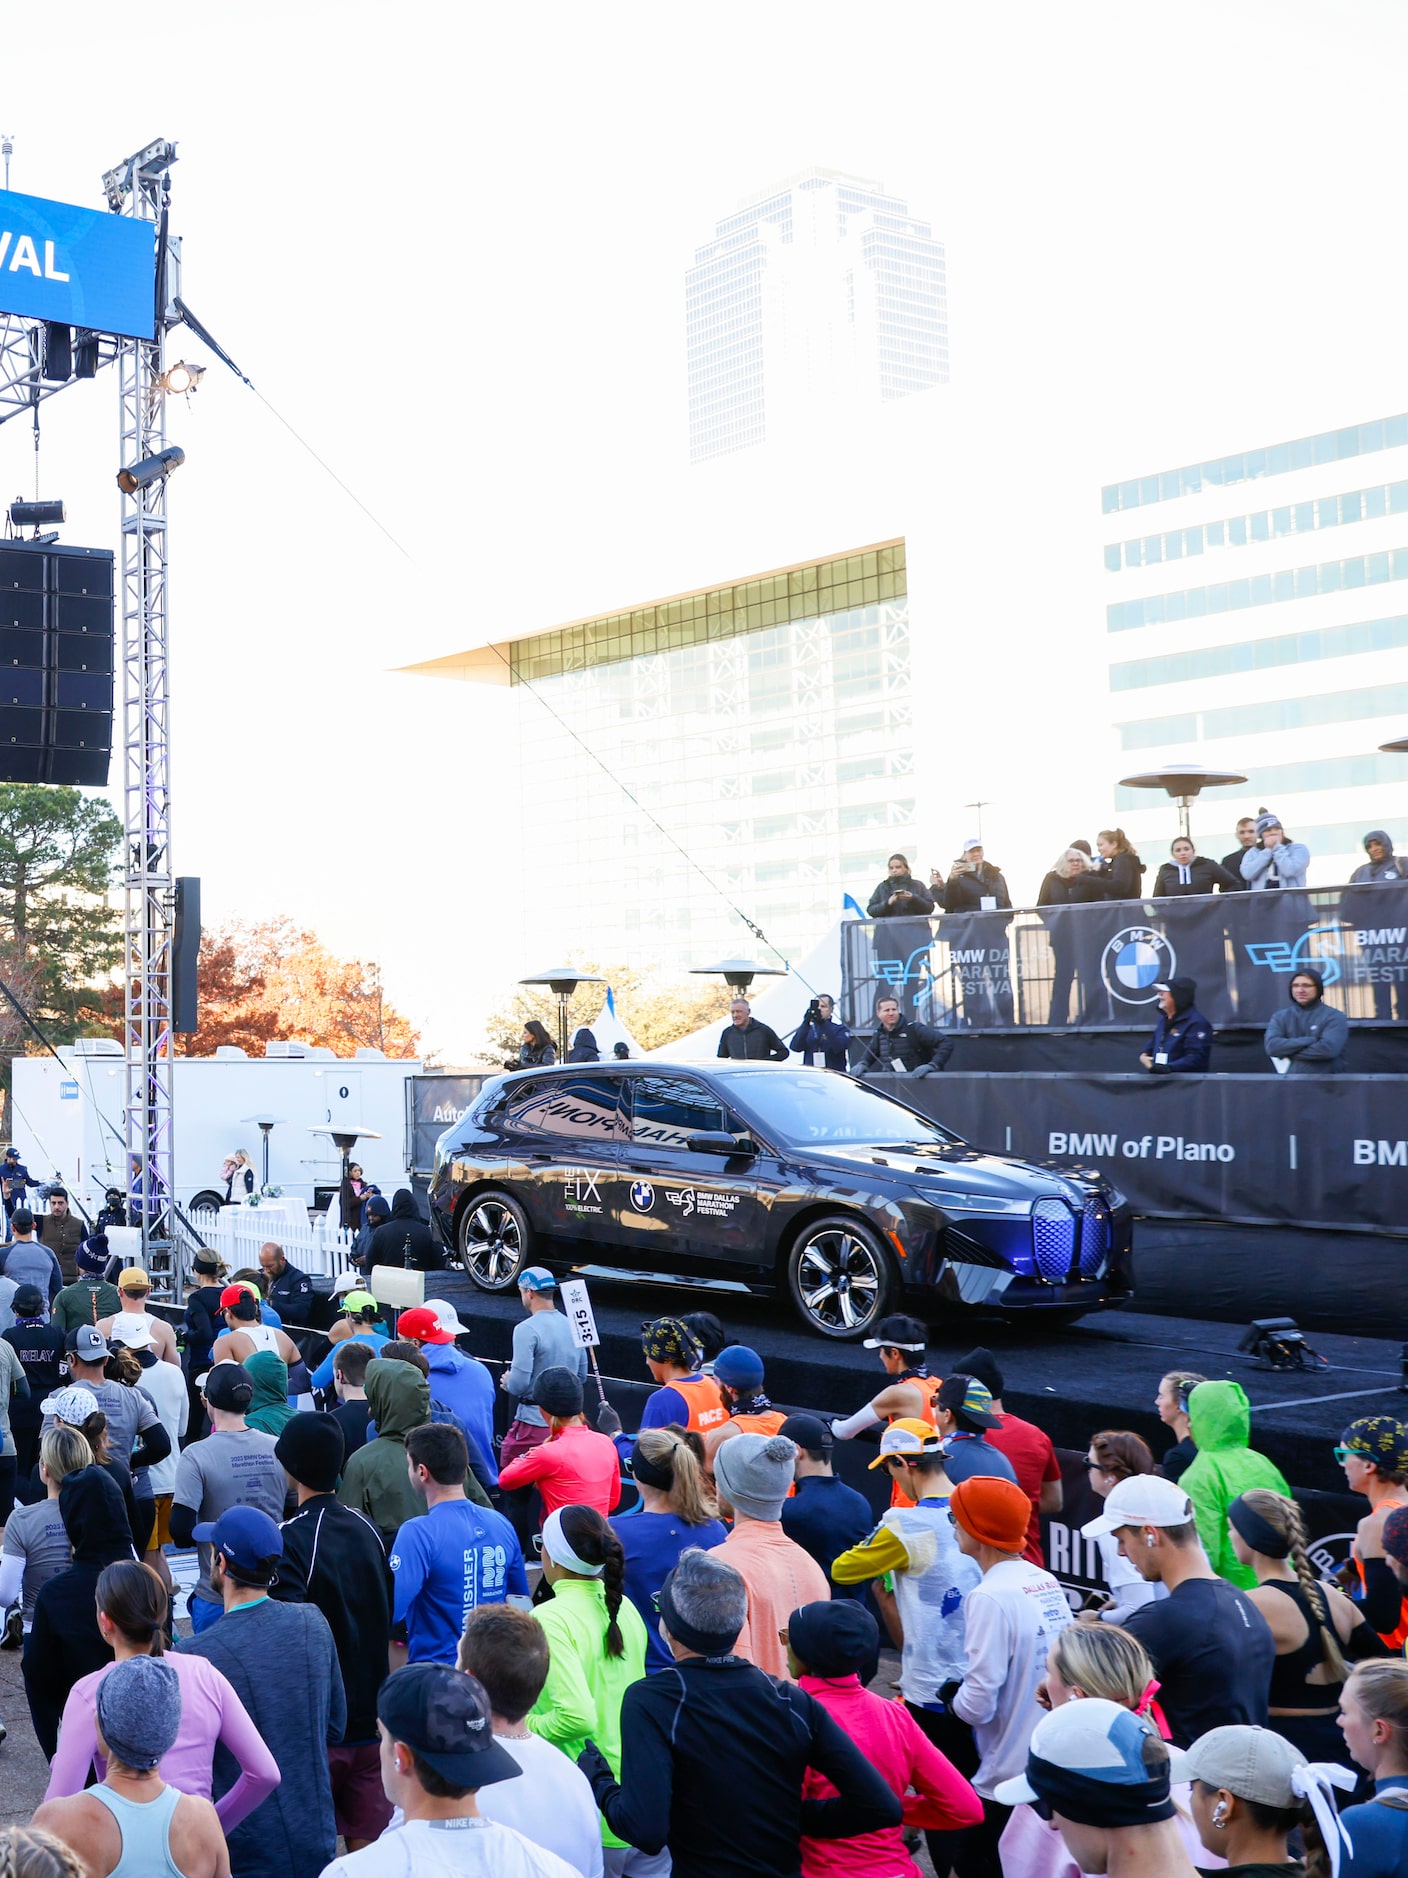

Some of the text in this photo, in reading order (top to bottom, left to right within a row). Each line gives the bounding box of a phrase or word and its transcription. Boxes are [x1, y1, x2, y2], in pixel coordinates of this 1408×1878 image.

[1354, 928, 1407, 946] BMW
[433, 1105, 469, 1122] Auto
[1049, 1132, 1236, 1162] BMW of Plano
[1354, 1139, 1408, 1167] BM
[564, 1168, 575, 1199] THE
[697, 1192, 740, 1204] BMW DALLAS
[697, 1199, 735, 1210] MARATHON
[696, 1206, 728, 1217] FESTIVAL
[575, 1309, 593, 1343] 3:15
[20, 1349, 55, 1362] RELAY
[698, 1407, 723, 1427] PACE
[444, 1818, 468, 1829] NIKE
